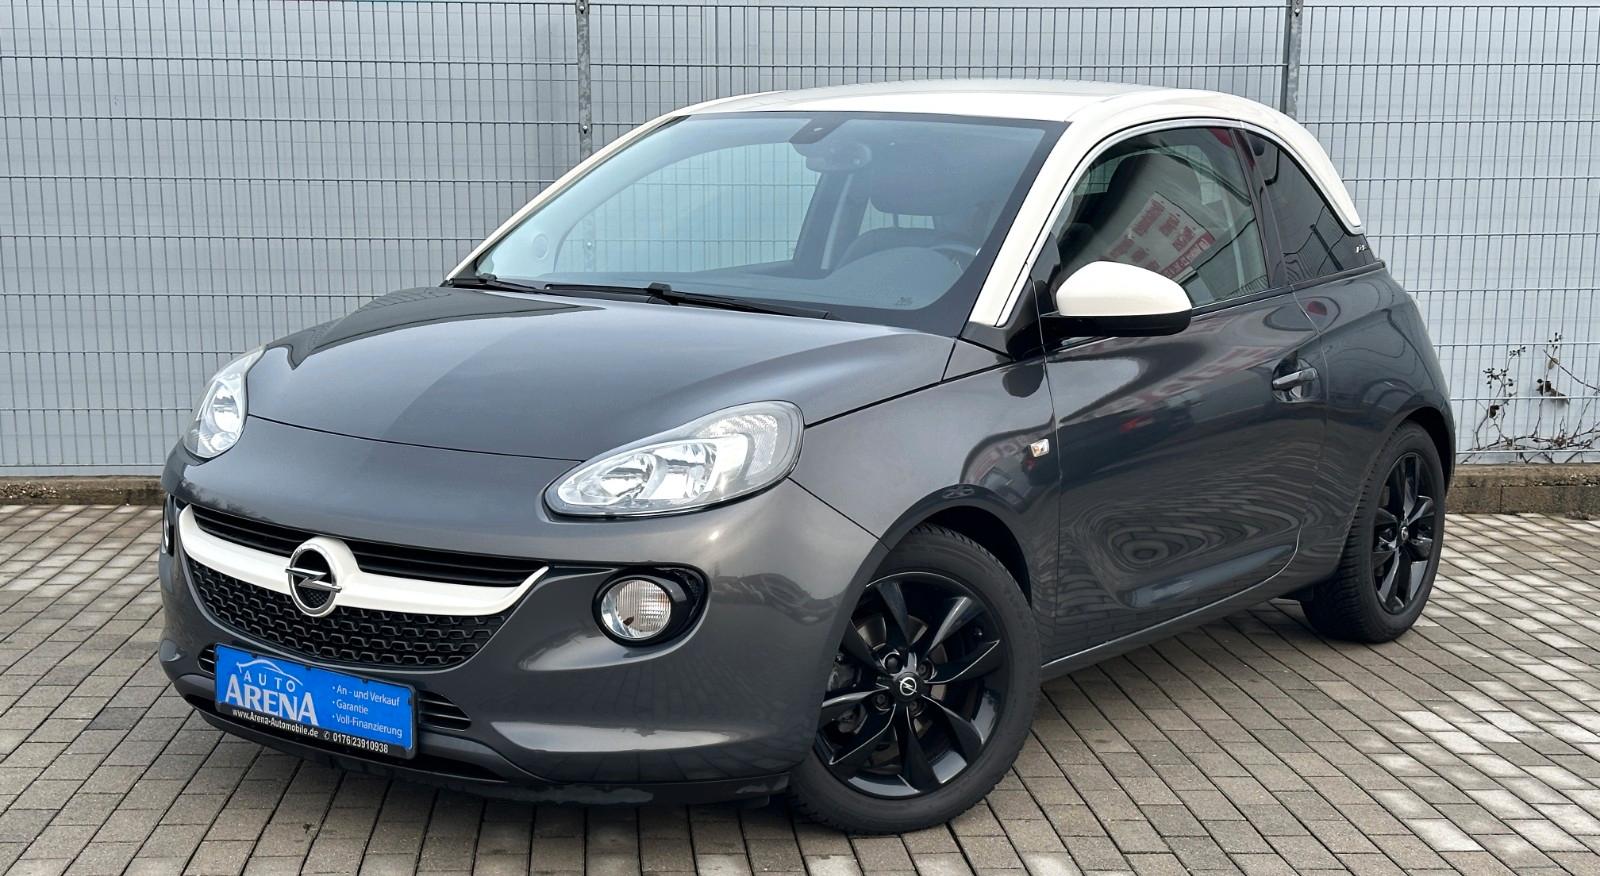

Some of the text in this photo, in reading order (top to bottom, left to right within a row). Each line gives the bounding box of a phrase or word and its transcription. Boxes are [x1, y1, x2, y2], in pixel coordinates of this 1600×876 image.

[243, 671, 296, 693] AUTO
[225, 674, 320, 727] ARENA
[336, 684, 347, 695] An
[353, 690, 369, 701] und
[370, 691, 400, 706] Verkauf
[336, 699, 369, 715] Garantie
[232, 709, 318, 738] www.Arena-Automobile.de
[335, 713, 403, 738] Voll-Finanzierung
